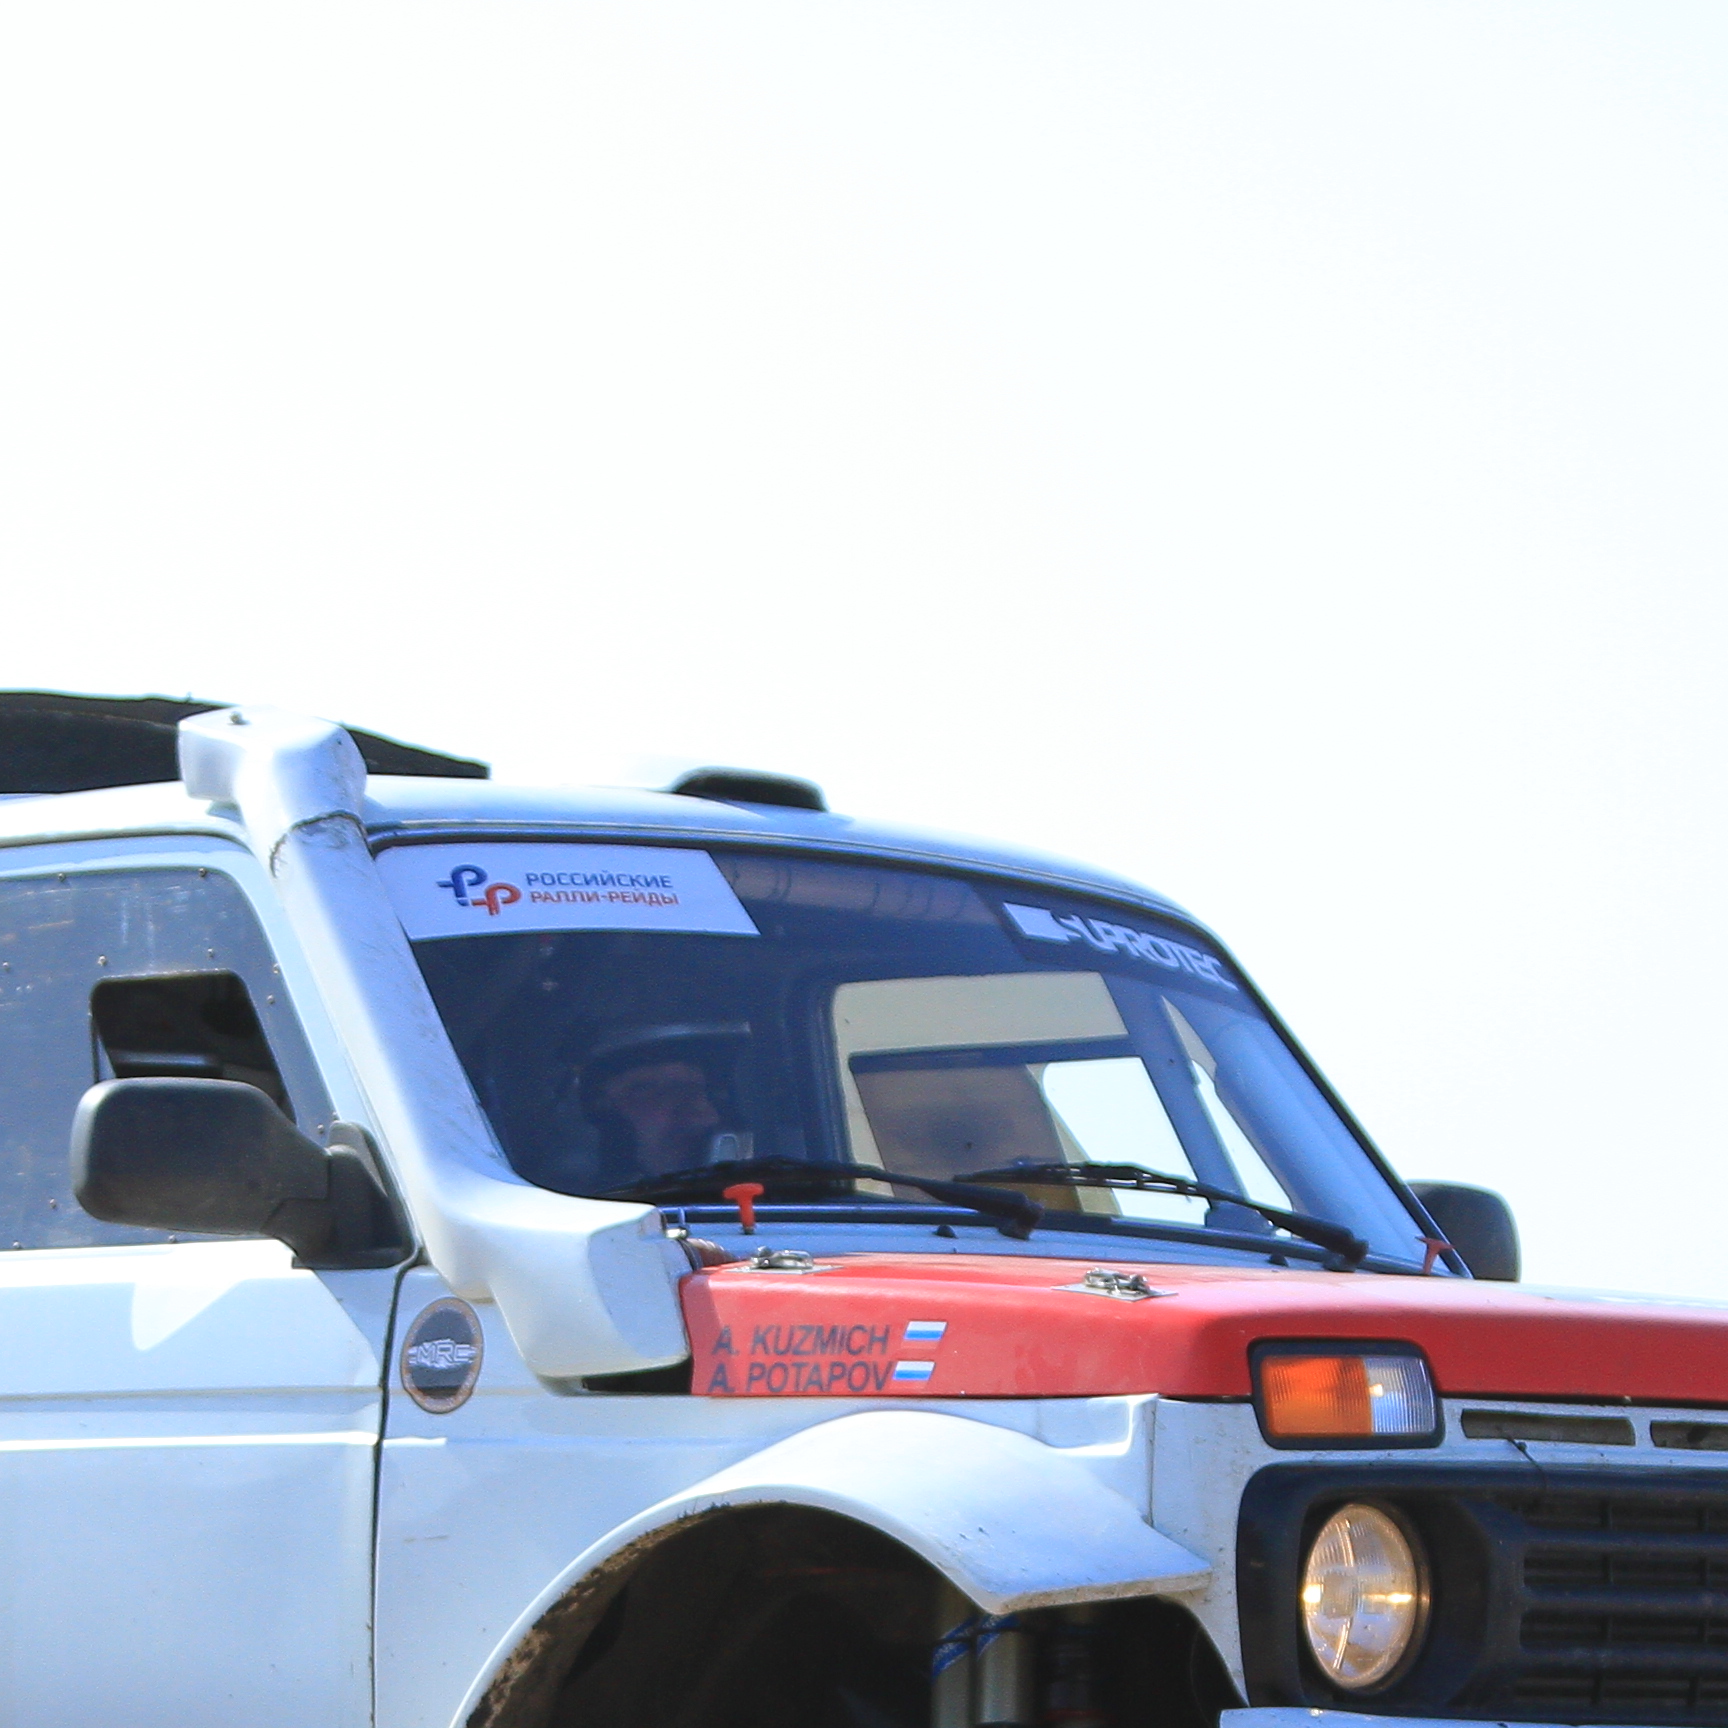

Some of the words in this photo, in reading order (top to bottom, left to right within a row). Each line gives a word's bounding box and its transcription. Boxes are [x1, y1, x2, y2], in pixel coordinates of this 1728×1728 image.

[525, 870, 673, 889] РОССИЙСКИЕ
[529, 890, 681, 906] РАЛЛИ-РЕЙДЫ
[1044, 909, 1240, 983] SUPROTEC
[711, 1325, 739, 1356] A.
[750, 1323, 891, 1357] KUZMICH
[707, 1361, 736, 1393] A.
[745, 1359, 893, 1393] POTAPOV
